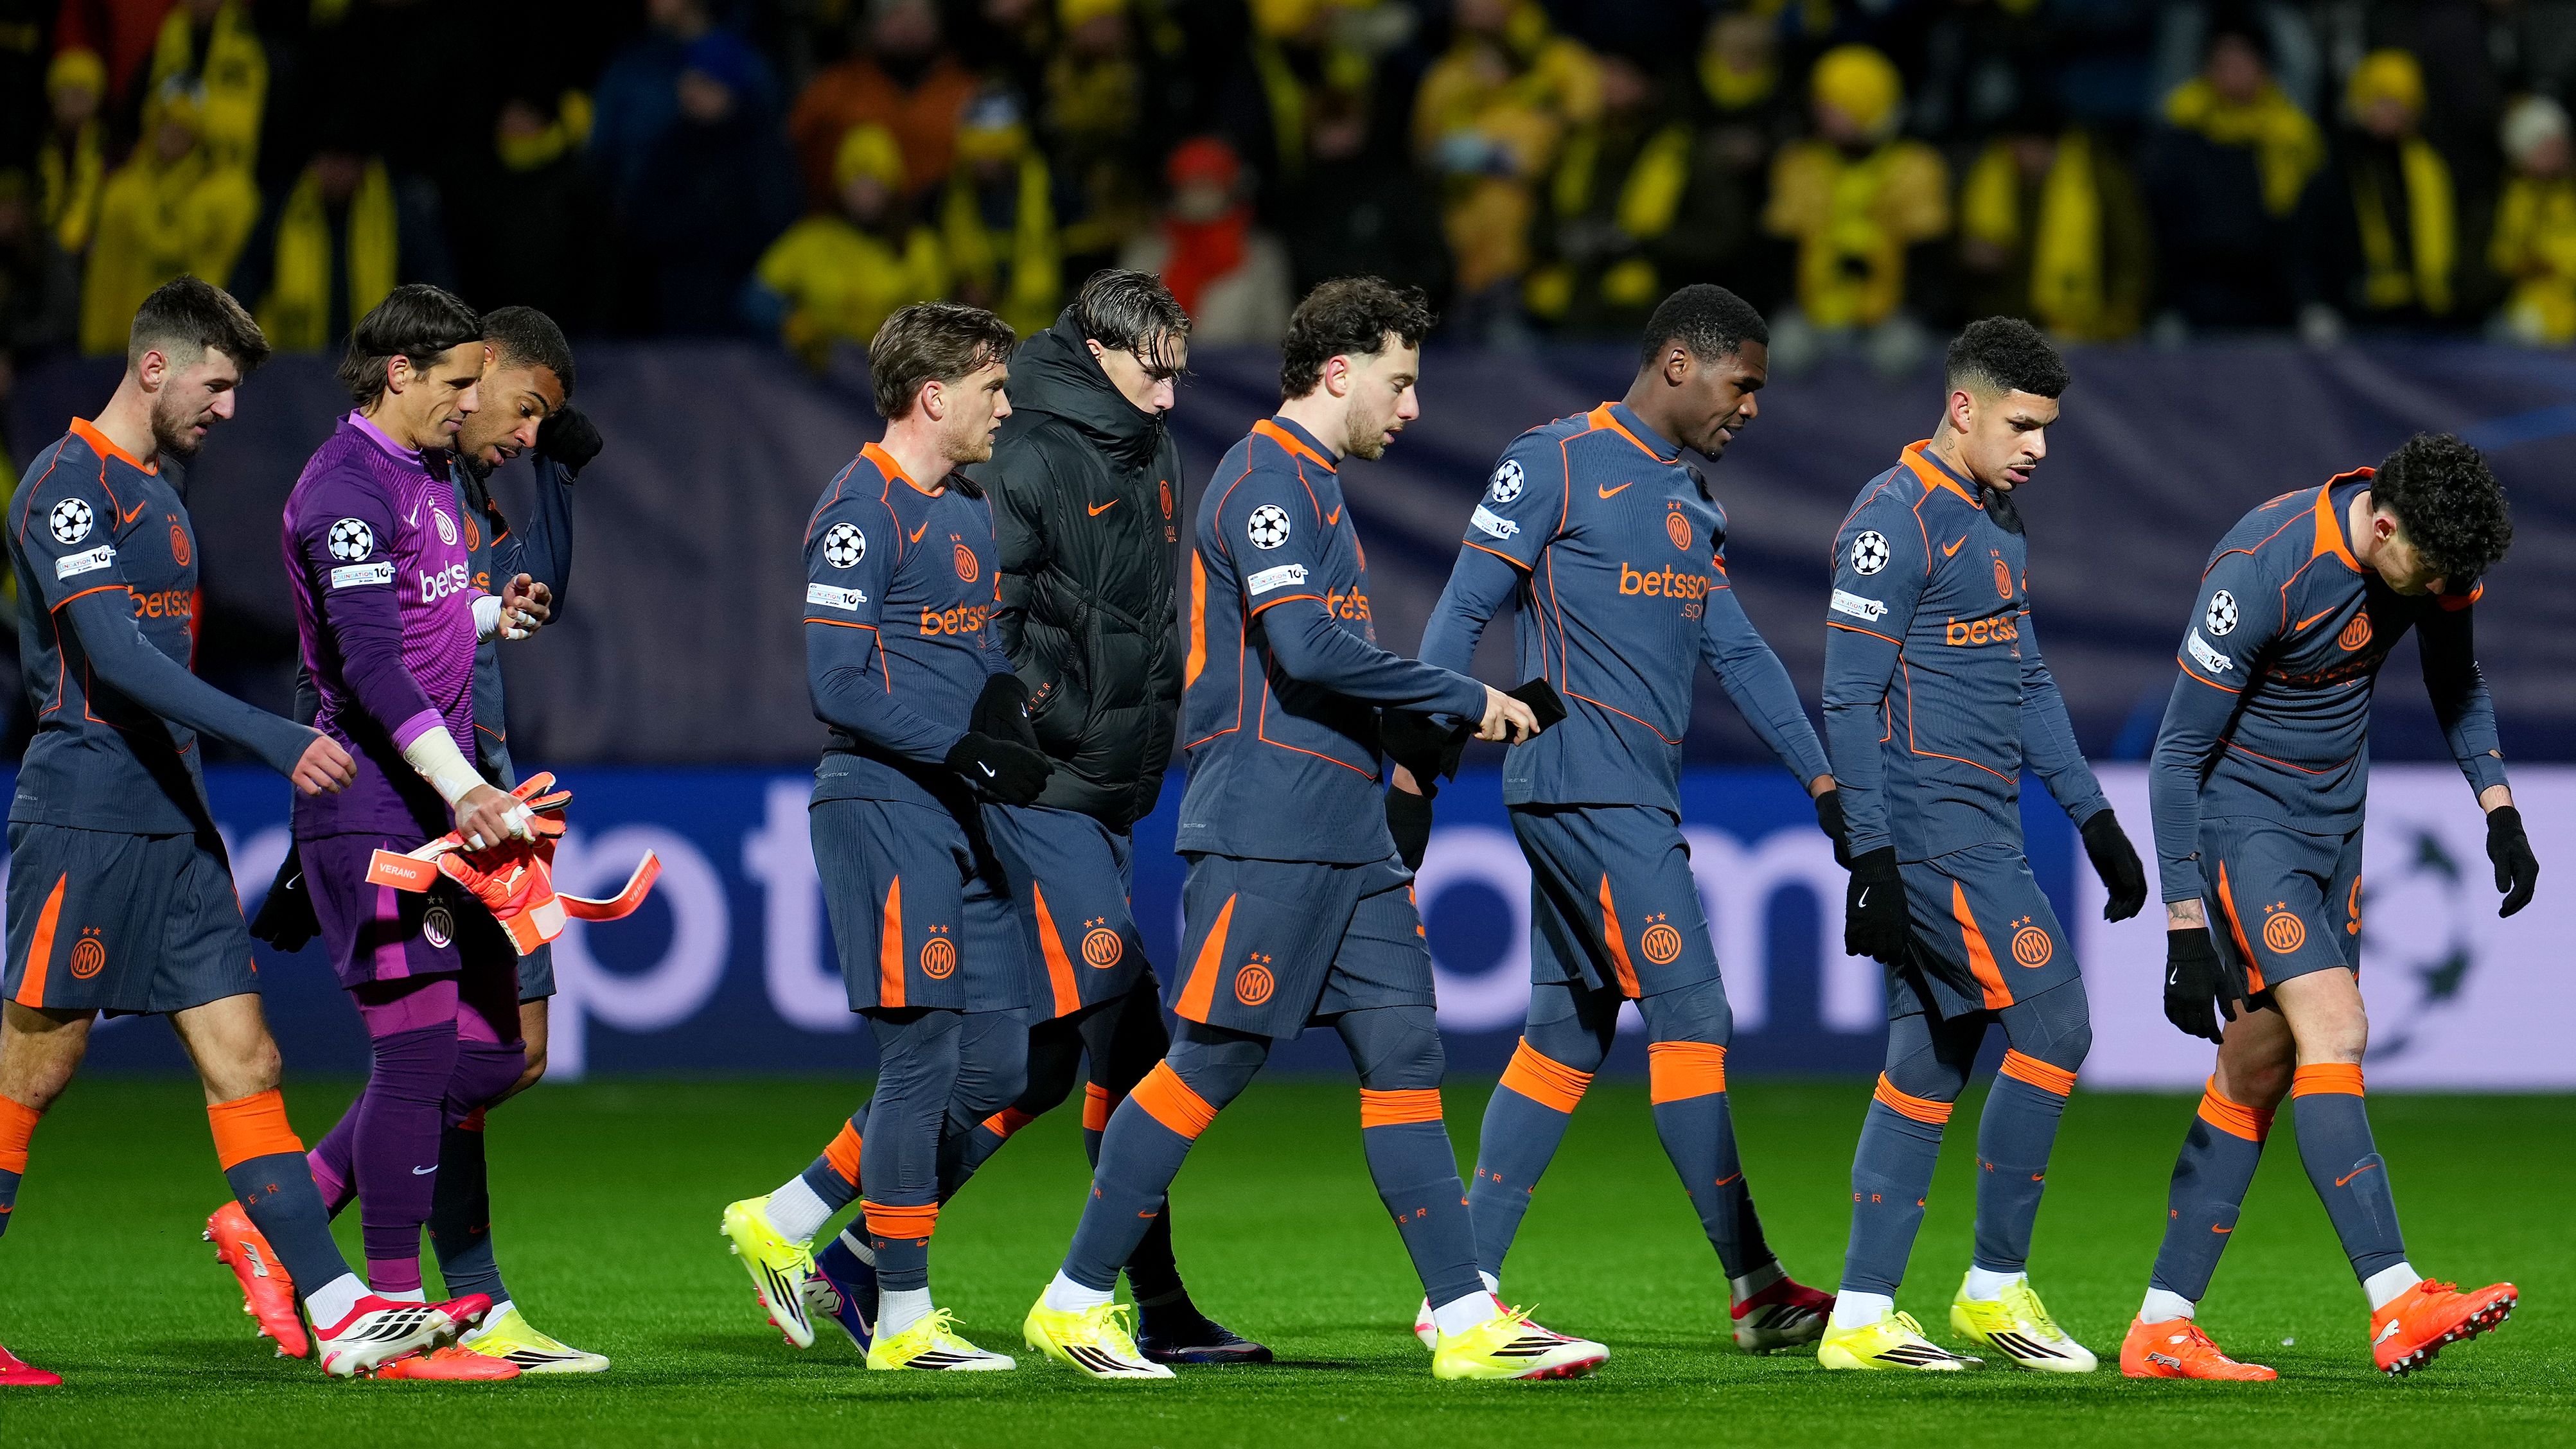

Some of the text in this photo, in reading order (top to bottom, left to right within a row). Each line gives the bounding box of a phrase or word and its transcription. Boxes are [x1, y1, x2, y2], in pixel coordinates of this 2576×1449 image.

[333, 572, 373, 581] FOUNDATION
[920, 599, 989, 636] betss
[1680, 602, 1702, 622] .sp
[1028, 682, 1050, 712] NTER
[380, 863, 417, 879] VERANO
[1474, 1166, 1502, 1183] ER
[248, 1183, 279, 1205] ER
[1851, 1193, 1882, 1203] ER
[1394, 1208, 1427, 1224] ER
